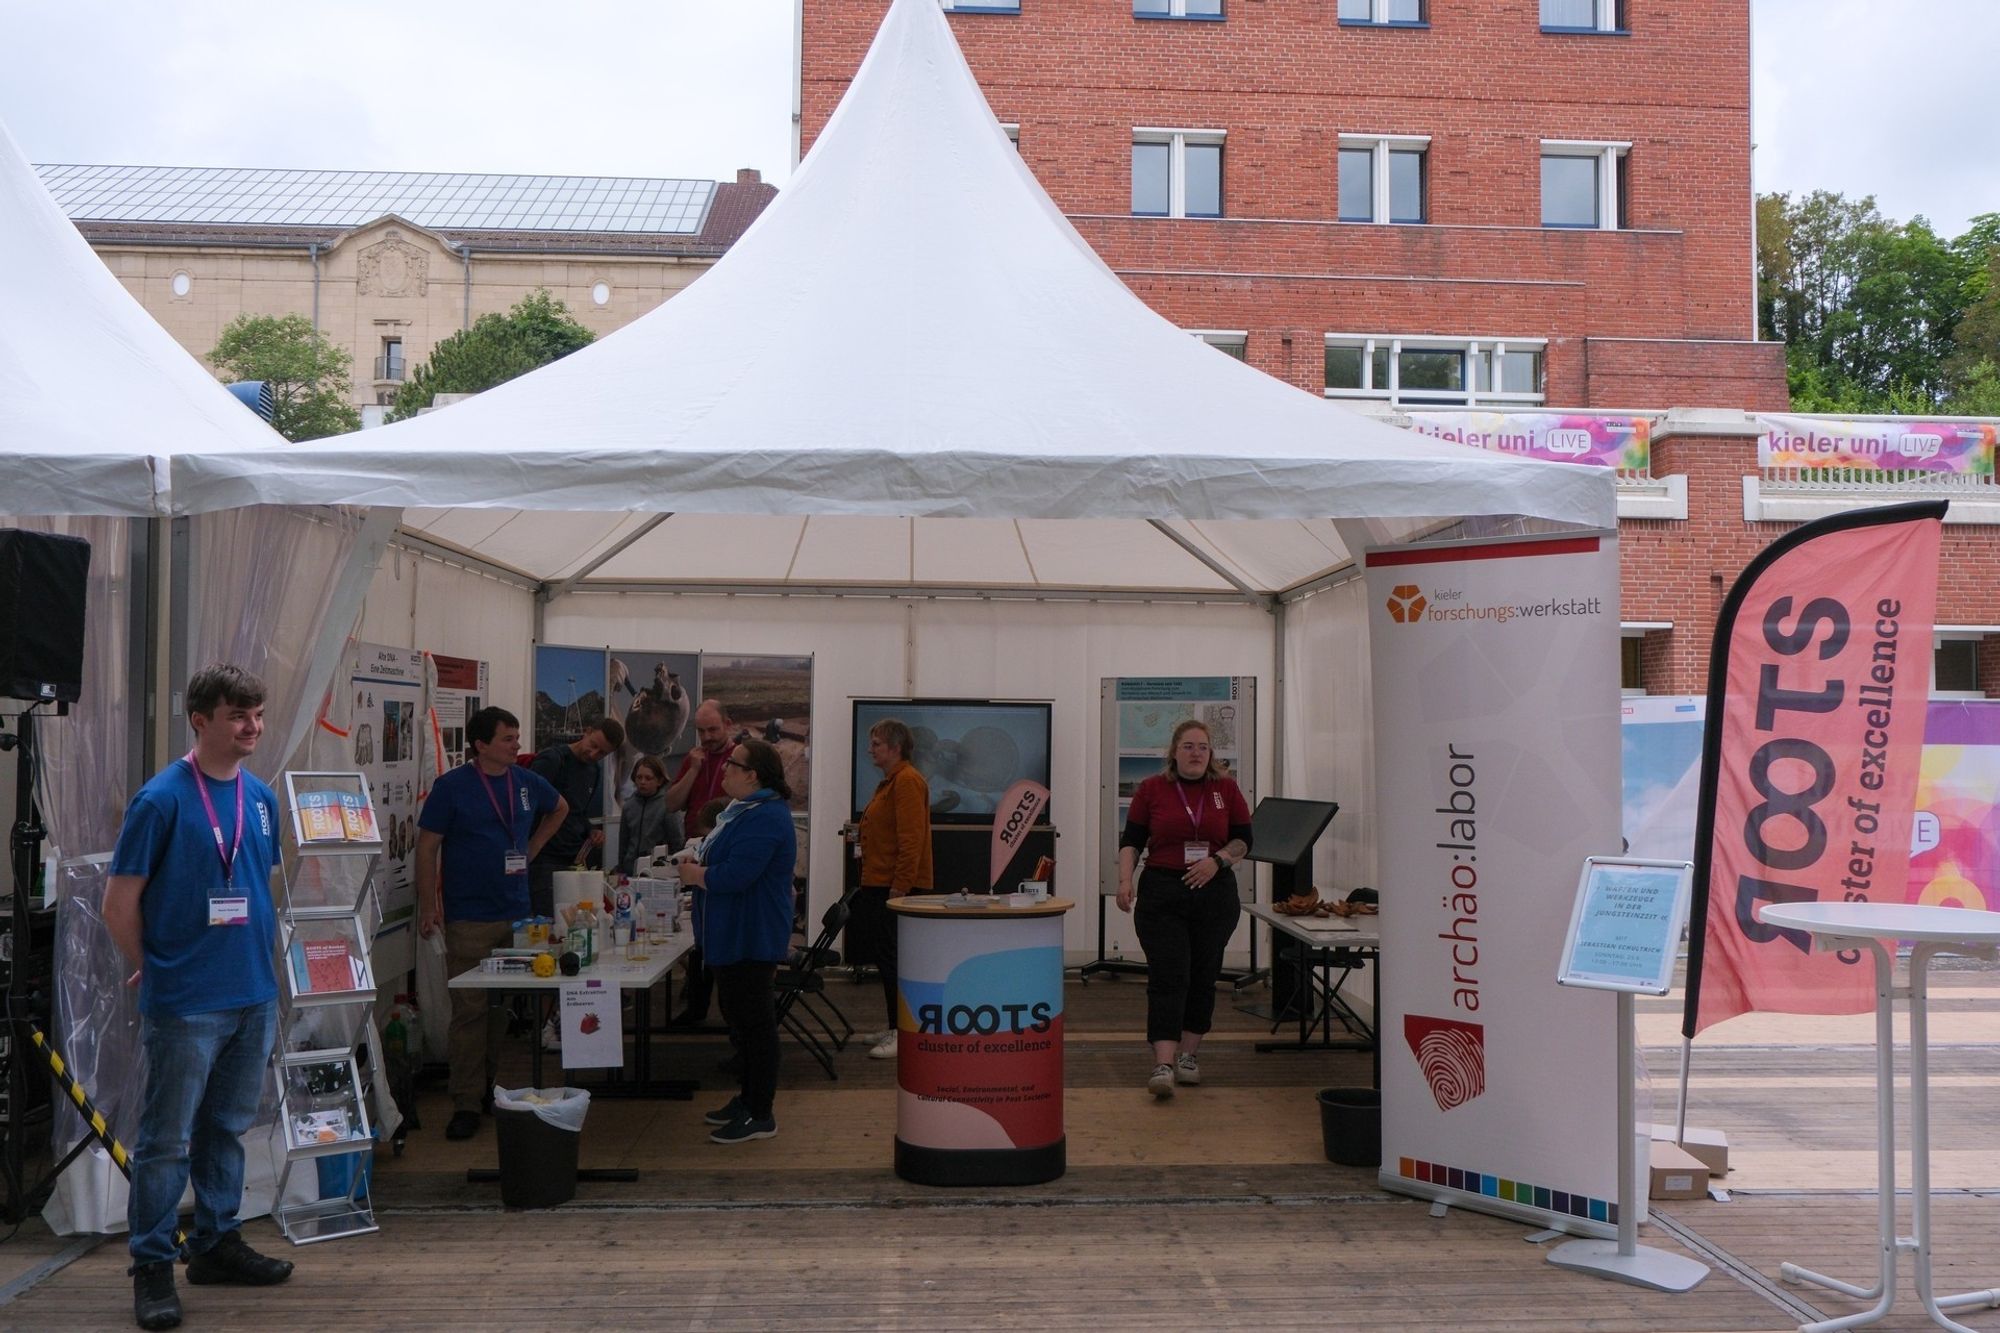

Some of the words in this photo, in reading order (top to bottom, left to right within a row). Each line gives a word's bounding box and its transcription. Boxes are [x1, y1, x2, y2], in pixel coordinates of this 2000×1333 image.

[1498, 430, 1535, 451] uni
[1551, 434, 1587, 449] LIVE
[1769, 431, 1843, 453] kieler
[1850, 434, 1888, 454] uni
[1904, 438, 1939, 453] LIVE
[1434, 588, 1462, 601] kieler
[1428, 597, 1601, 623] forschungs:werkstatt
[1858, 598, 1902, 791] excellence
[1848, 796, 1880, 835] of
[1435, 743, 1480, 1011] archäo:labor
[1836, 837, 1876, 964] cster
[918, 1040, 963, 1052] cluster
[967, 1040, 981, 1053] of
[984, 1039, 1052, 1052] excellence
